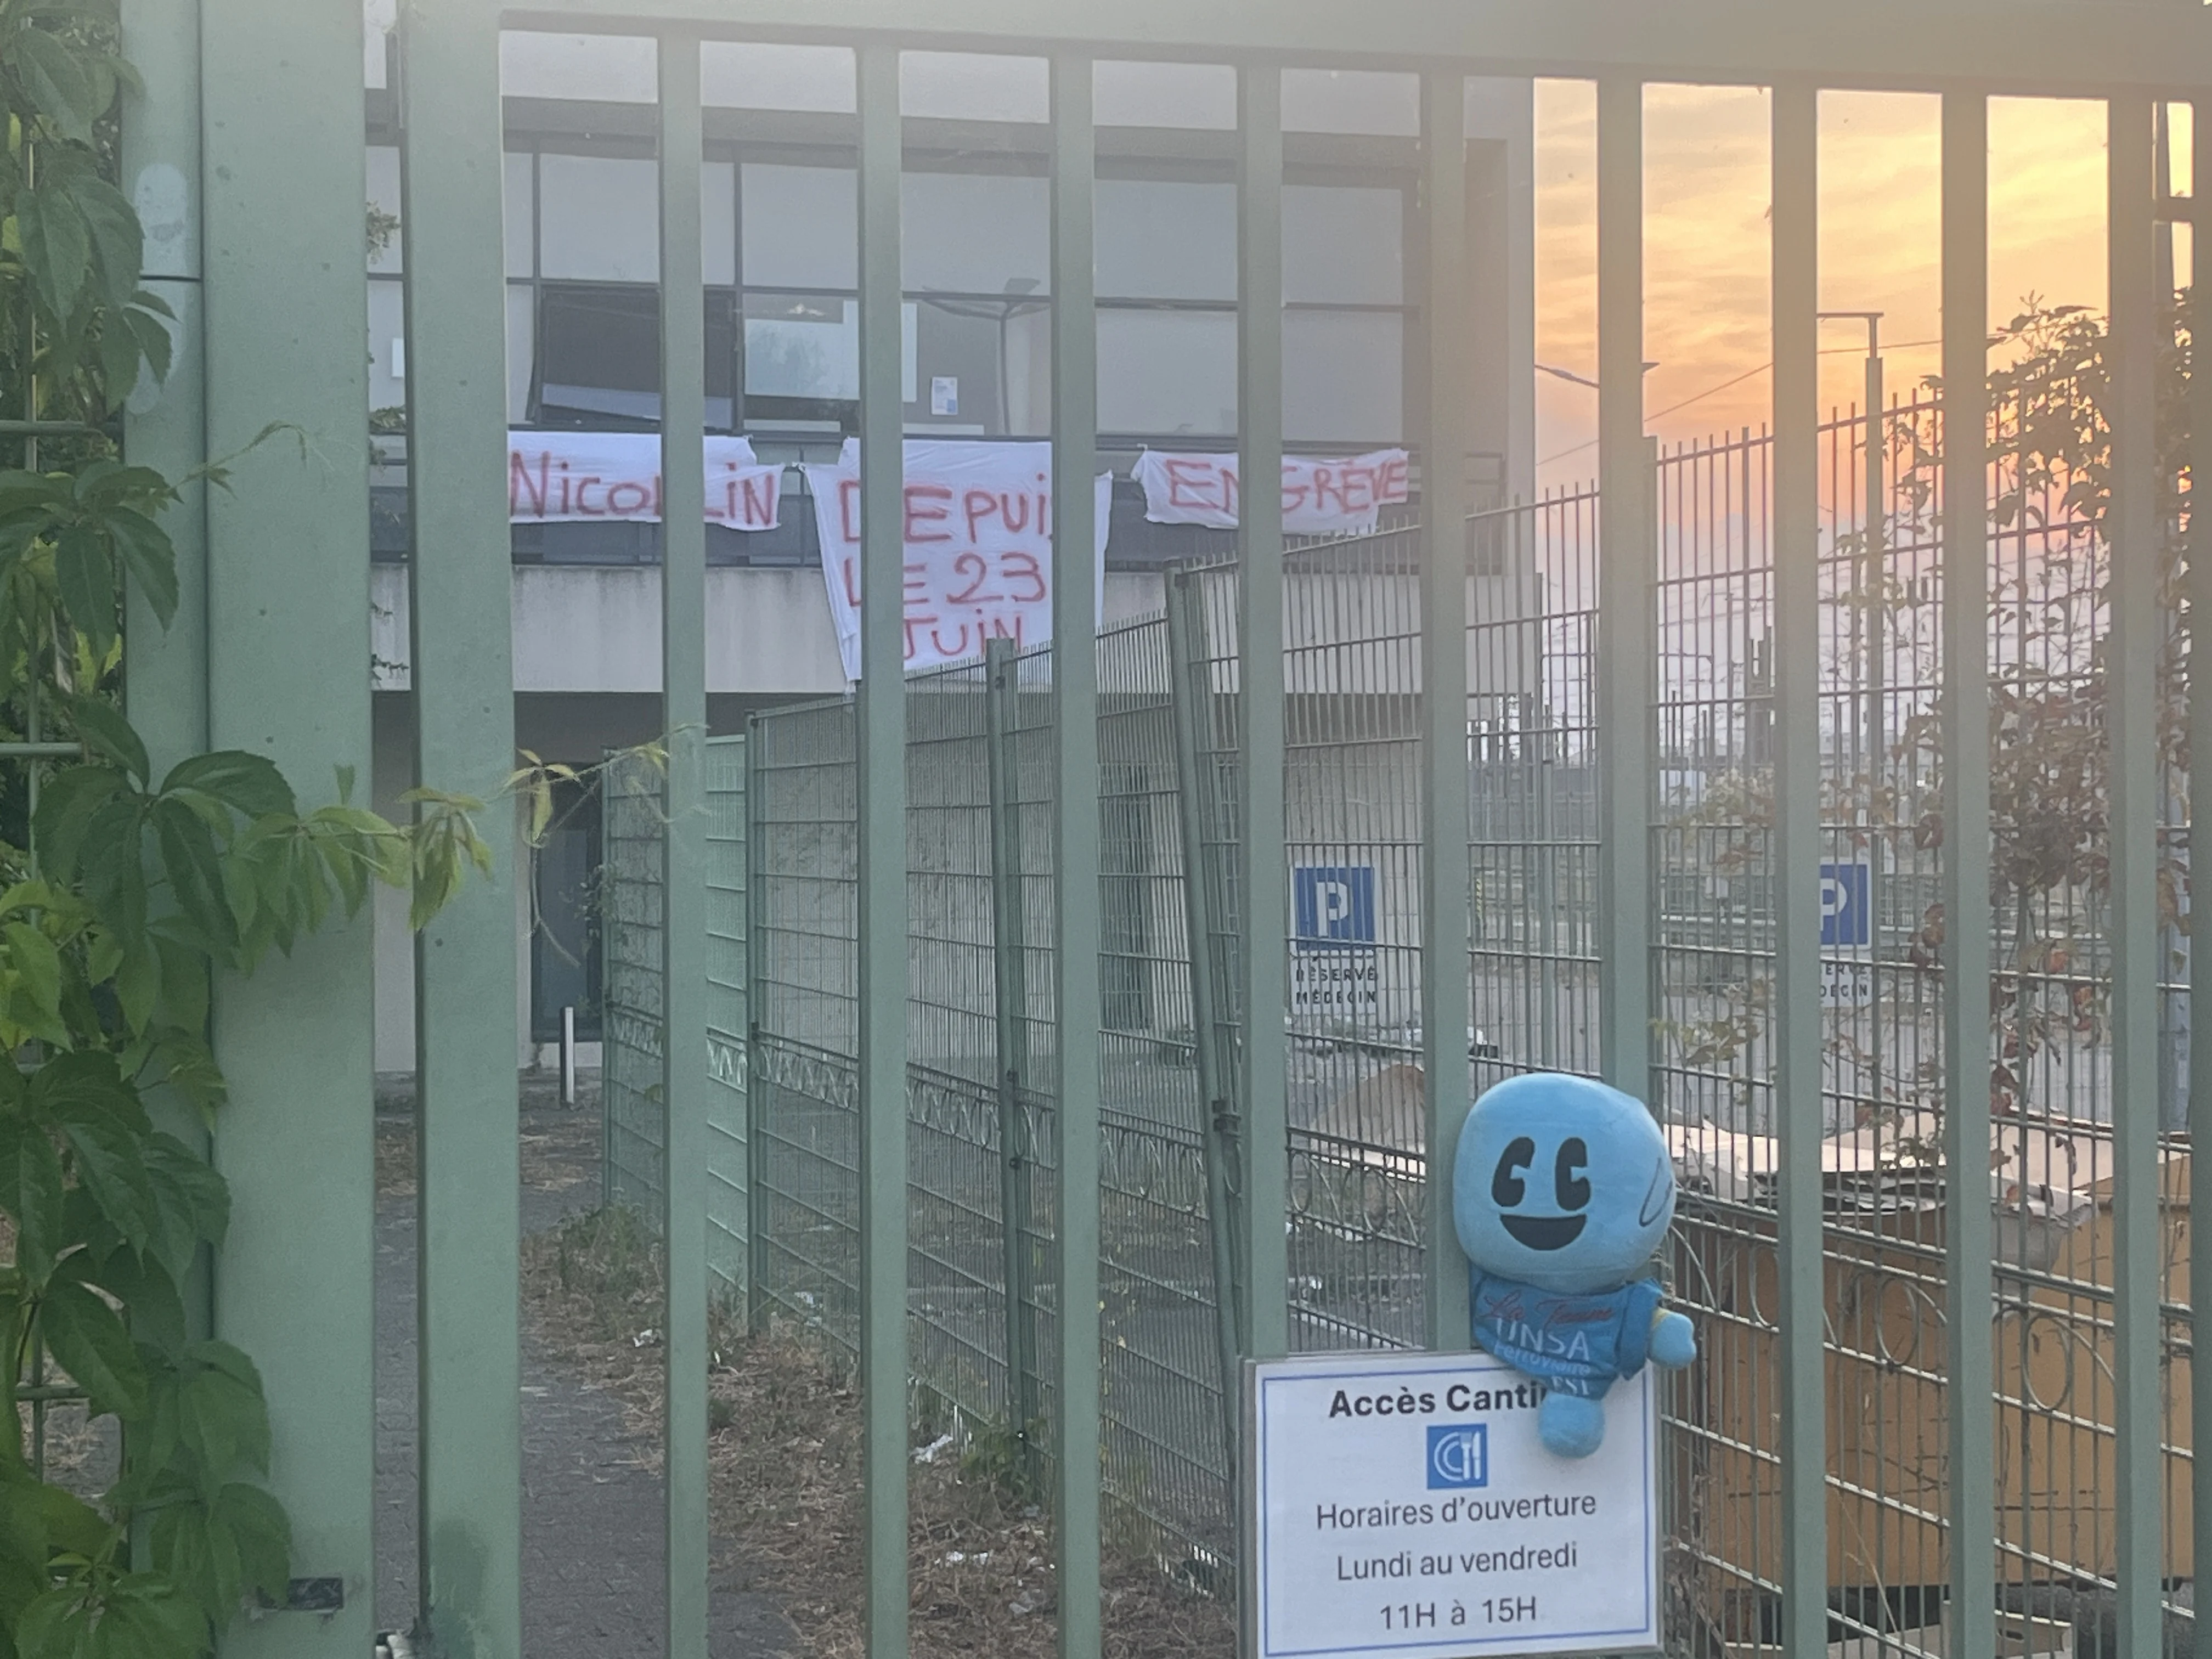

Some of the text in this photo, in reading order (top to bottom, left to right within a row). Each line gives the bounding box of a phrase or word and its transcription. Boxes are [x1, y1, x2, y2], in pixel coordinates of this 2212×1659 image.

[946, 552, 1046, 603] 23
[1317, 882, 1349, 937] P
[1820, 878, 1847, 931] P
[1496, 1316, 1590, 1362] UNSA
[1329, 1380, 1547, 1418] Accès Canti
[1317, 1494, 1596, 1530] Horaires d'ouverture
[1338, 1541, 1577, 1581] Lundi au vendredi
[1380, 1596, 1537, 1630] 11H à 15H
